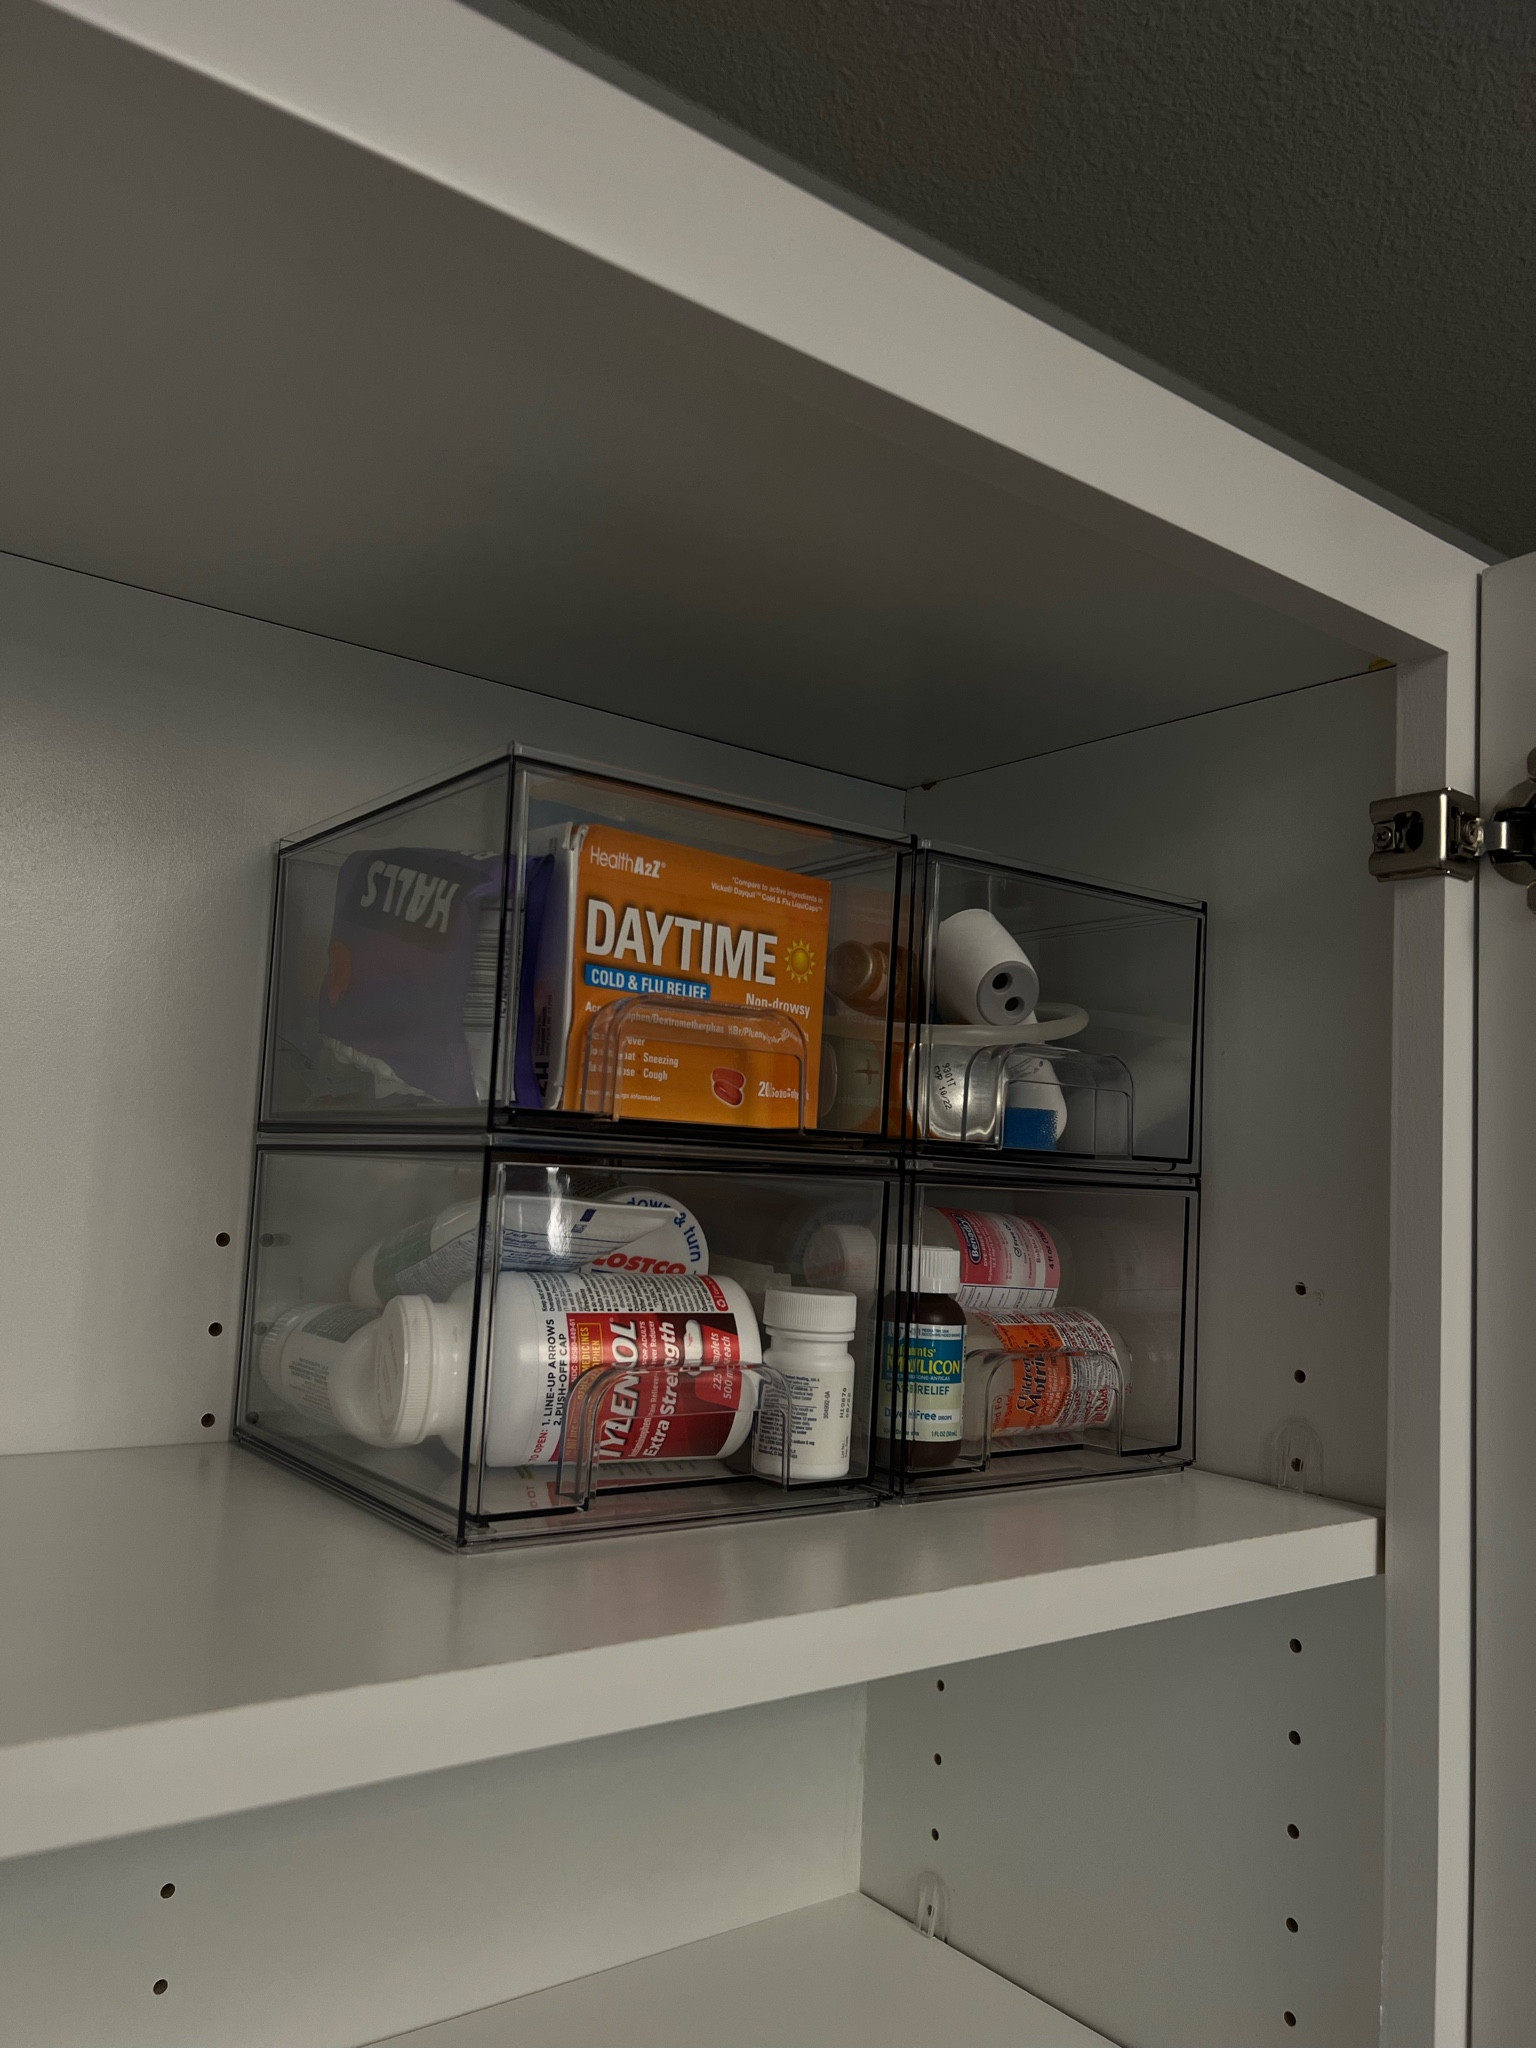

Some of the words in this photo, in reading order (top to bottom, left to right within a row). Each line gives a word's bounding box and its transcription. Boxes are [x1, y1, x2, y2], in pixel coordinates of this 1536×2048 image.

[361, 860, 460, 933] HALLS
[586, 899, 778, 985] DAYTIME
[591, 968, 624, 989] COLD
[628, 975, 638, 991] &
[641, 977, 664, 993] FLU
[666, 981, 707, 999] RELIEF
[746, 993, 811, 1019] Non-drowsy
[643, 1052, 679, 1068] Sneezing
[643, 1068, 668, 1082] Cough
[939, 1086, 952, 1110] 10/22
[674, 1212, 687, 1228] &
[683, 1226, 701, 1262] turn
[579, 1289, 590, 1312] Directions
[546, 1319, 556, 1369] ARROWS
[558, 1333, 567, 1356] CAP
[580, 1327, 590, 1372] MEDICINES
[555, 1360, 567, 1416] PUSH-OFF
[598, 1320, 640, 1458] TYLENOL
[713, 1372, 722, 1390] 225
[723, 1383, 733, 1399] 500
[917, 1385, 950, 1396] RELIEF
[543, 1372, 556, 1417] LINE-UP
[553, 1418, 562, 1426] 2.
[534, 1429, 548, 1454] OPEN:
[642, 1419, 670, 1457] Extra
